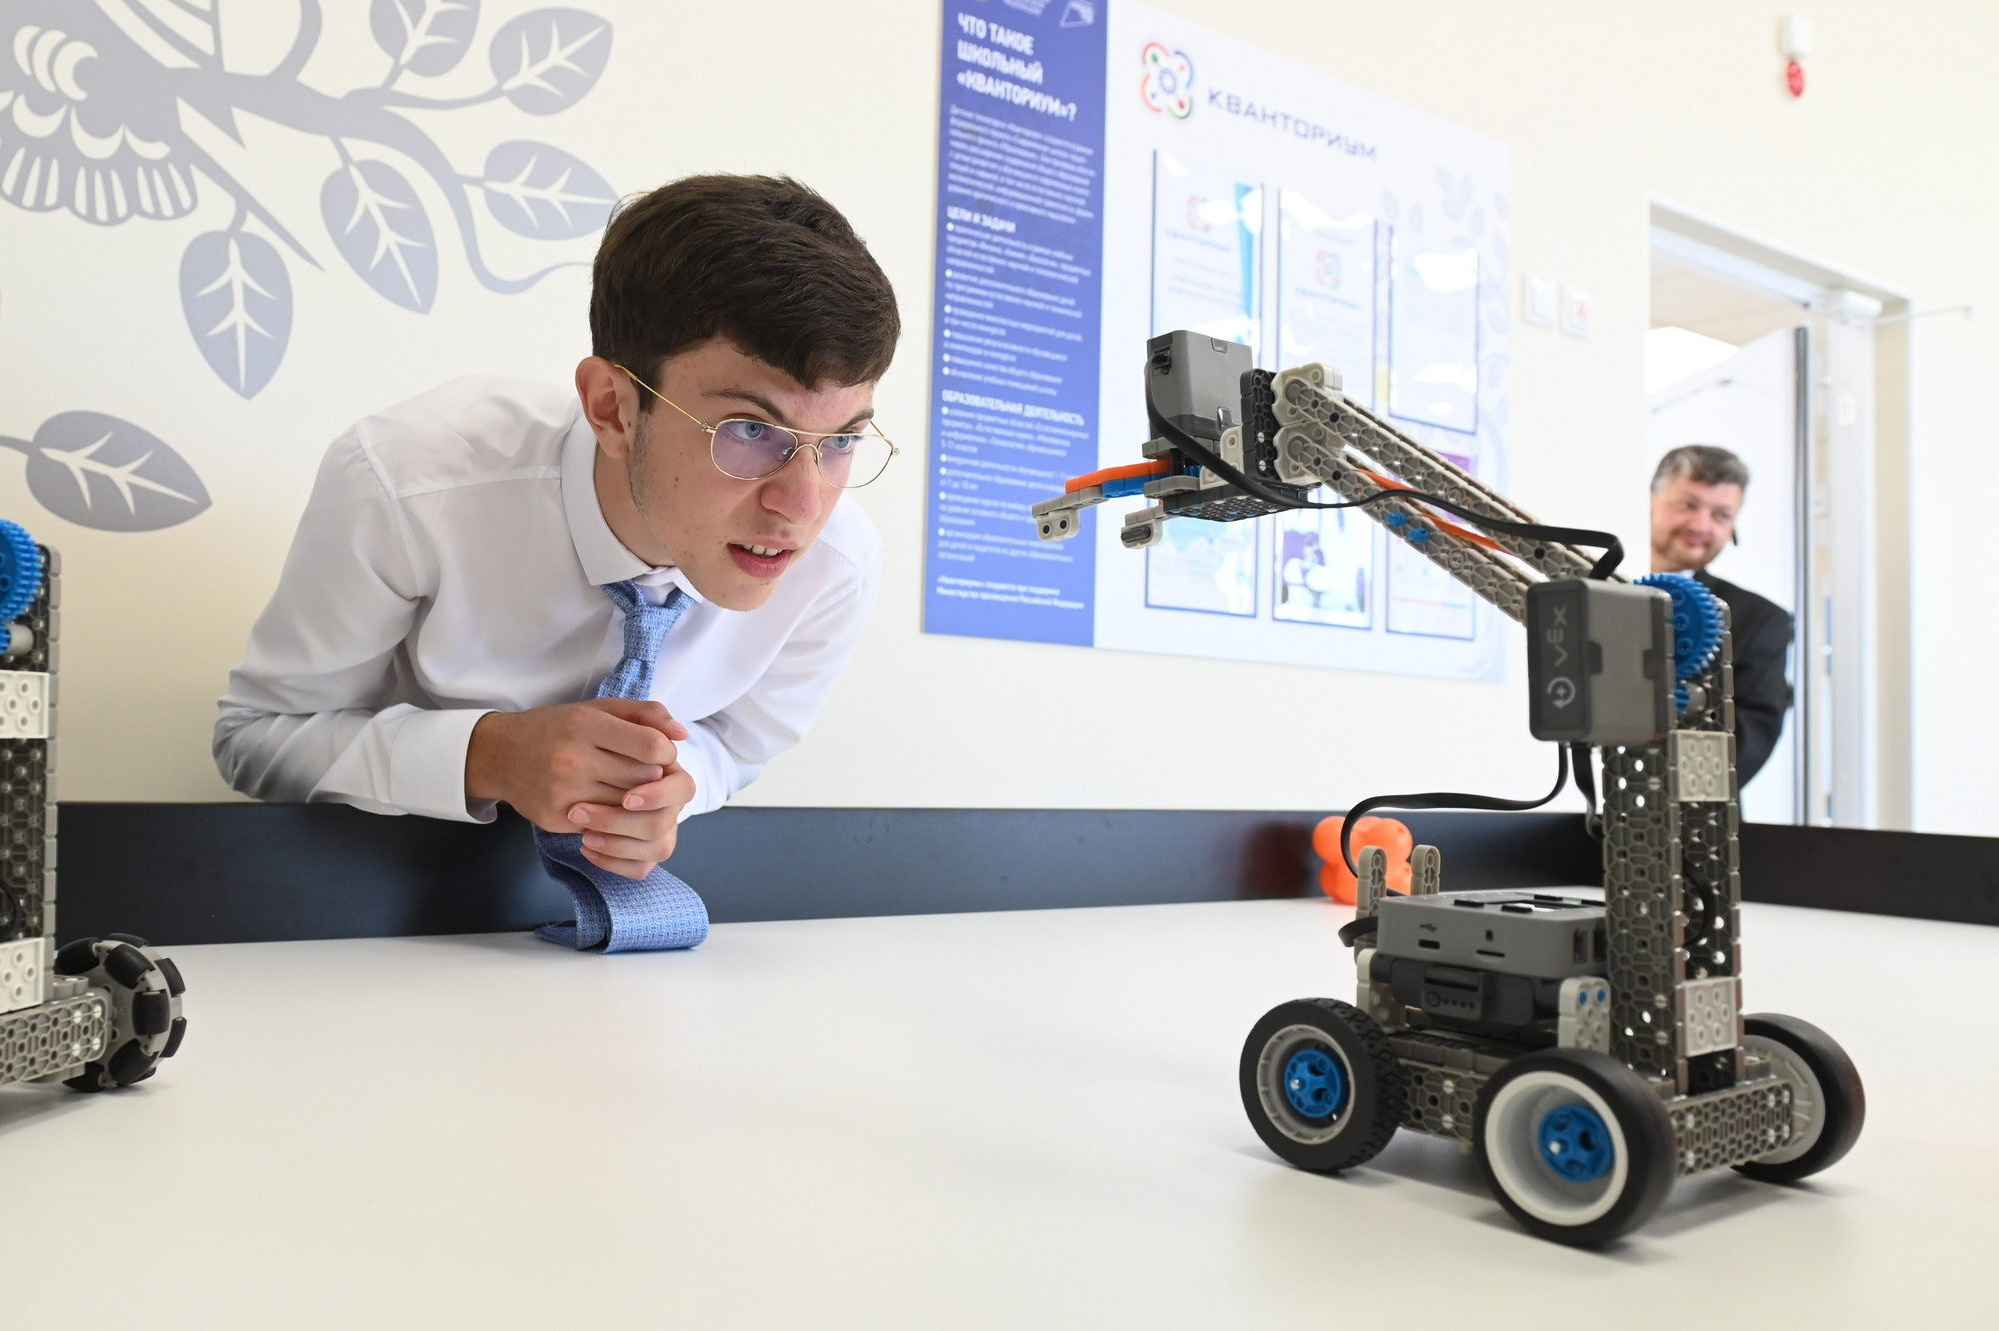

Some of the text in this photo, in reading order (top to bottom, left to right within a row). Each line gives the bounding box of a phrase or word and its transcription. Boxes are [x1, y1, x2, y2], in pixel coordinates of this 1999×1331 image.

[958, 12, 1034, 56] ЧТО ТАКОЕ
[957, 39, 1043, 85] ШКОЛЬНЫЙ
[1207, 87, 1377, 162] КВАНТОРИУМ
[1547, 605, 1568, 667] VEX
